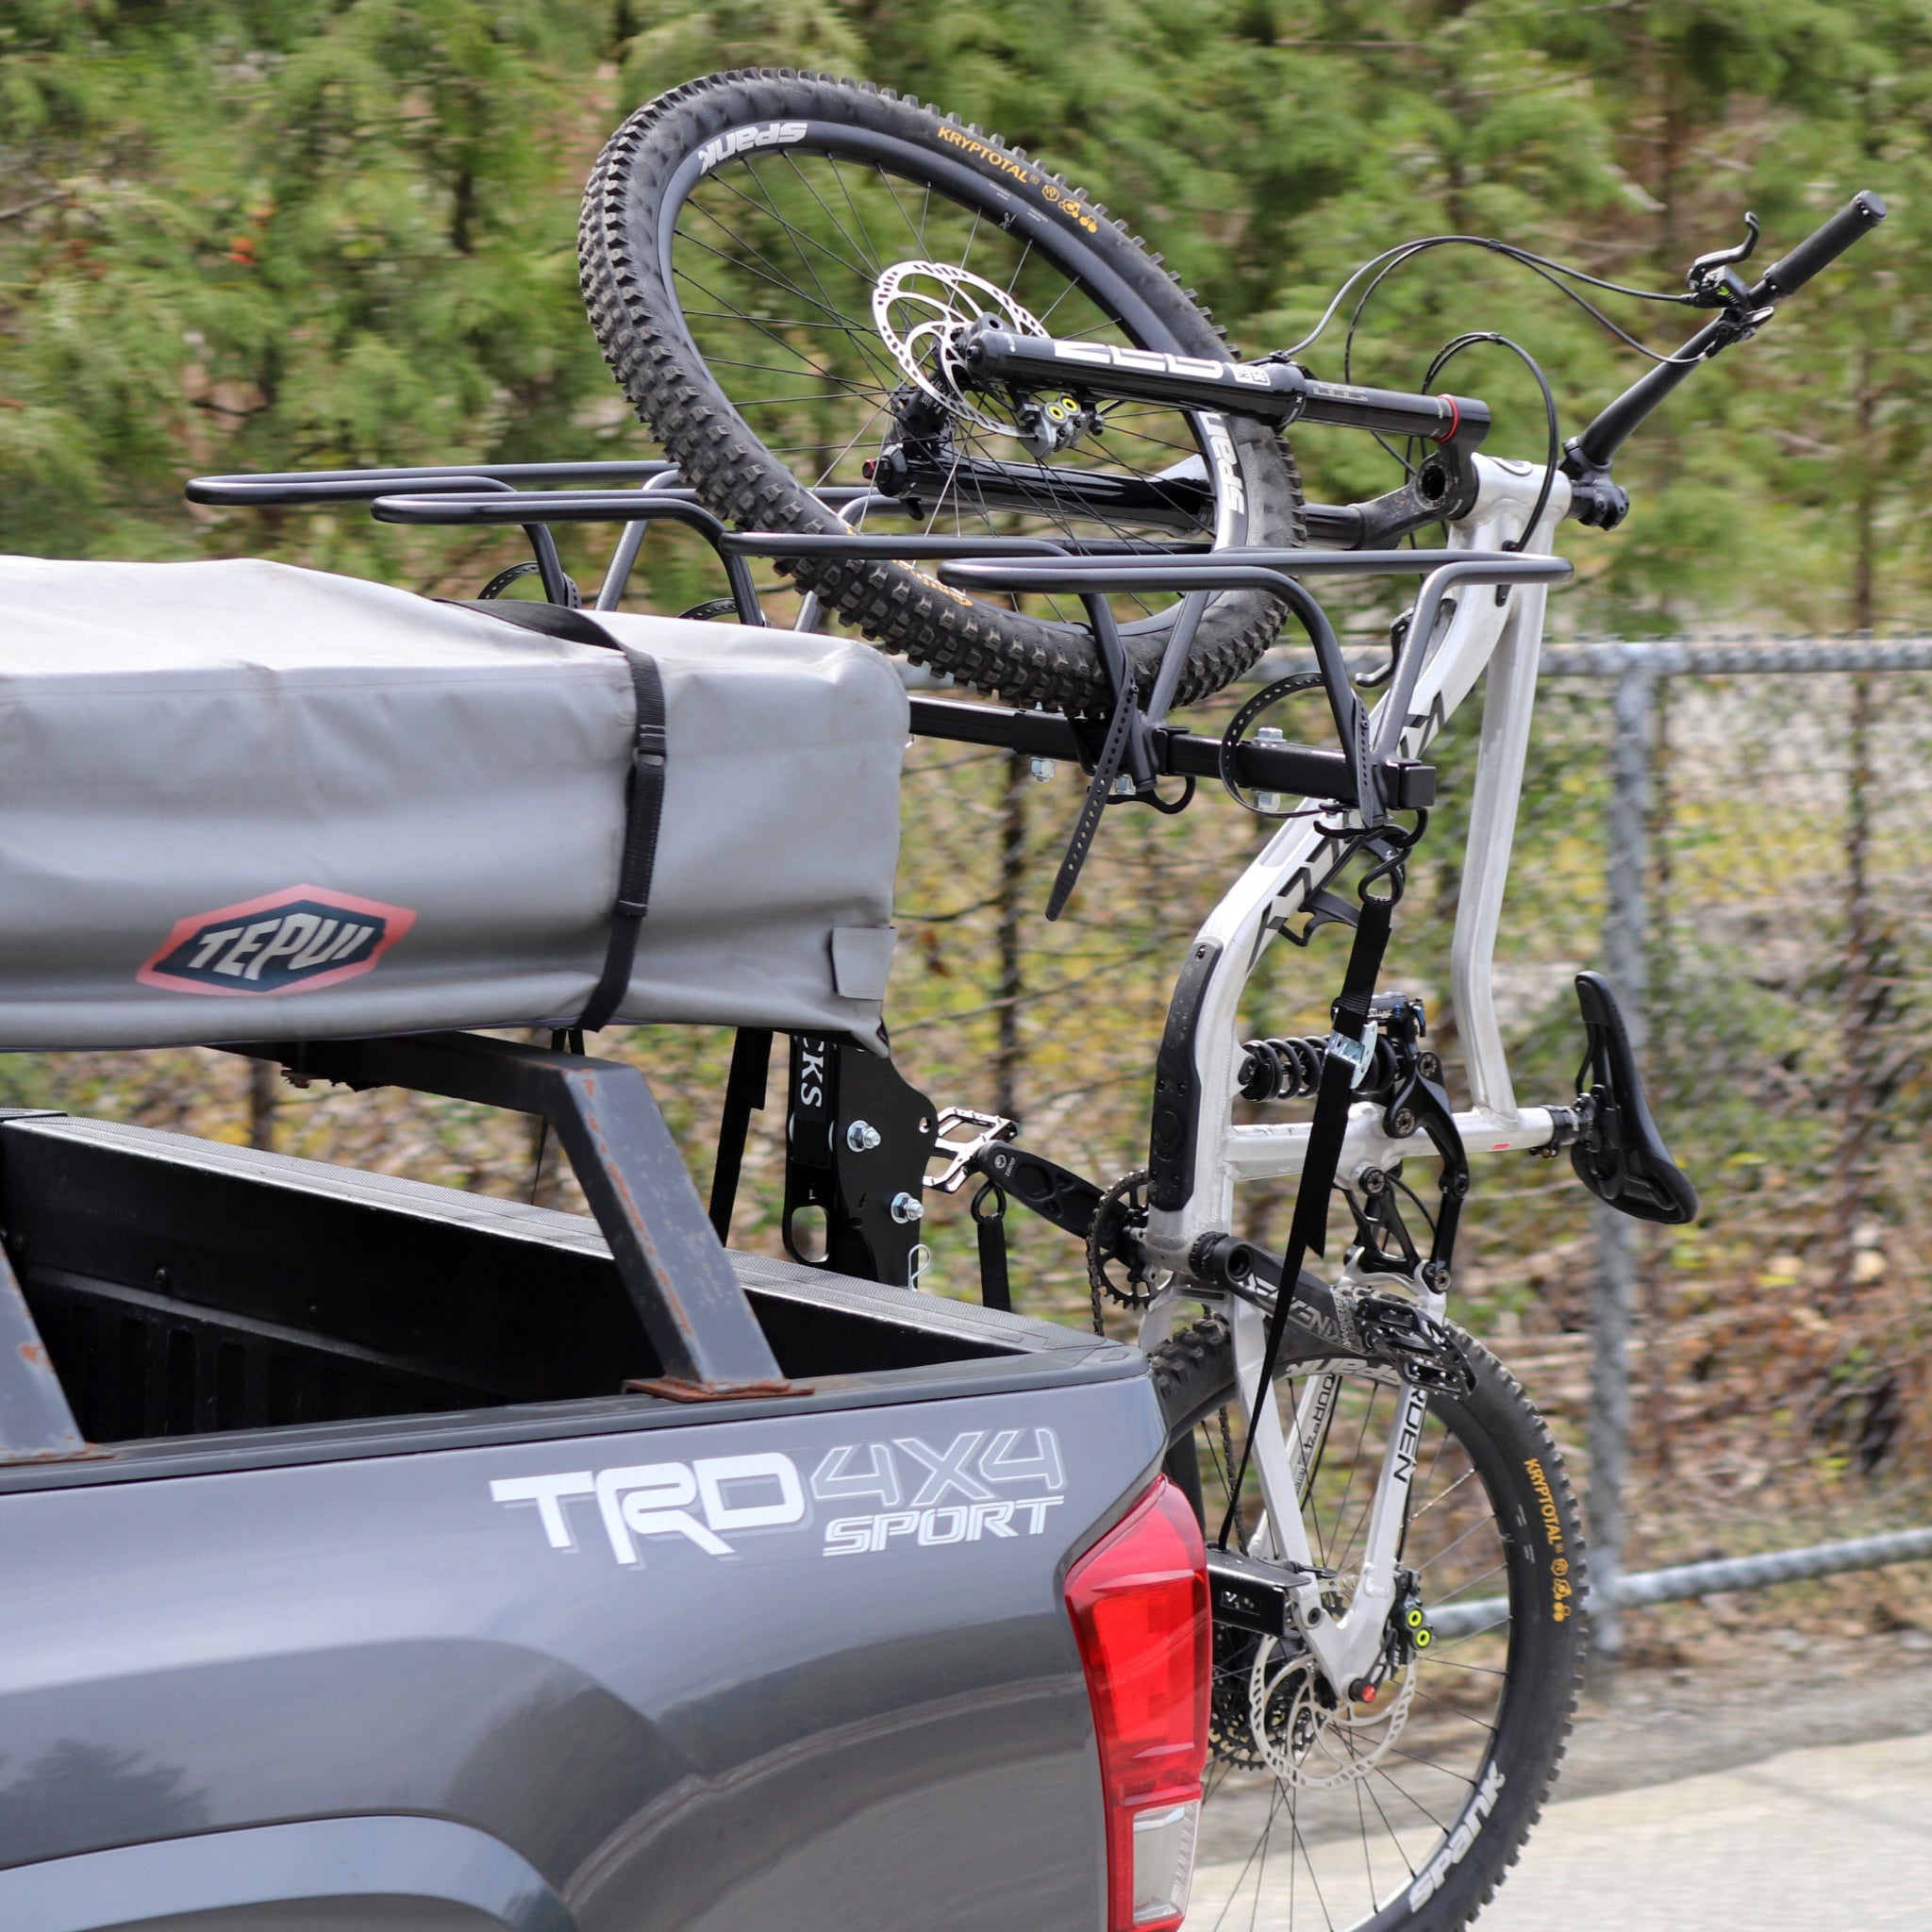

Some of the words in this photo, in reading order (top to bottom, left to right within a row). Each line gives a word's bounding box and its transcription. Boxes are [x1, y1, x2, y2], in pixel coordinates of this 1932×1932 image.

[938, 126, 1027, 183] KRYPTOTAL
[187, 912, 375, 981] TEPUI
[489, 1450, 808, 1568] TRD
[822, 1495, 1064, 1557] SPORT
[1524, 1457, 1563, 1546] KRYPTOTAL
